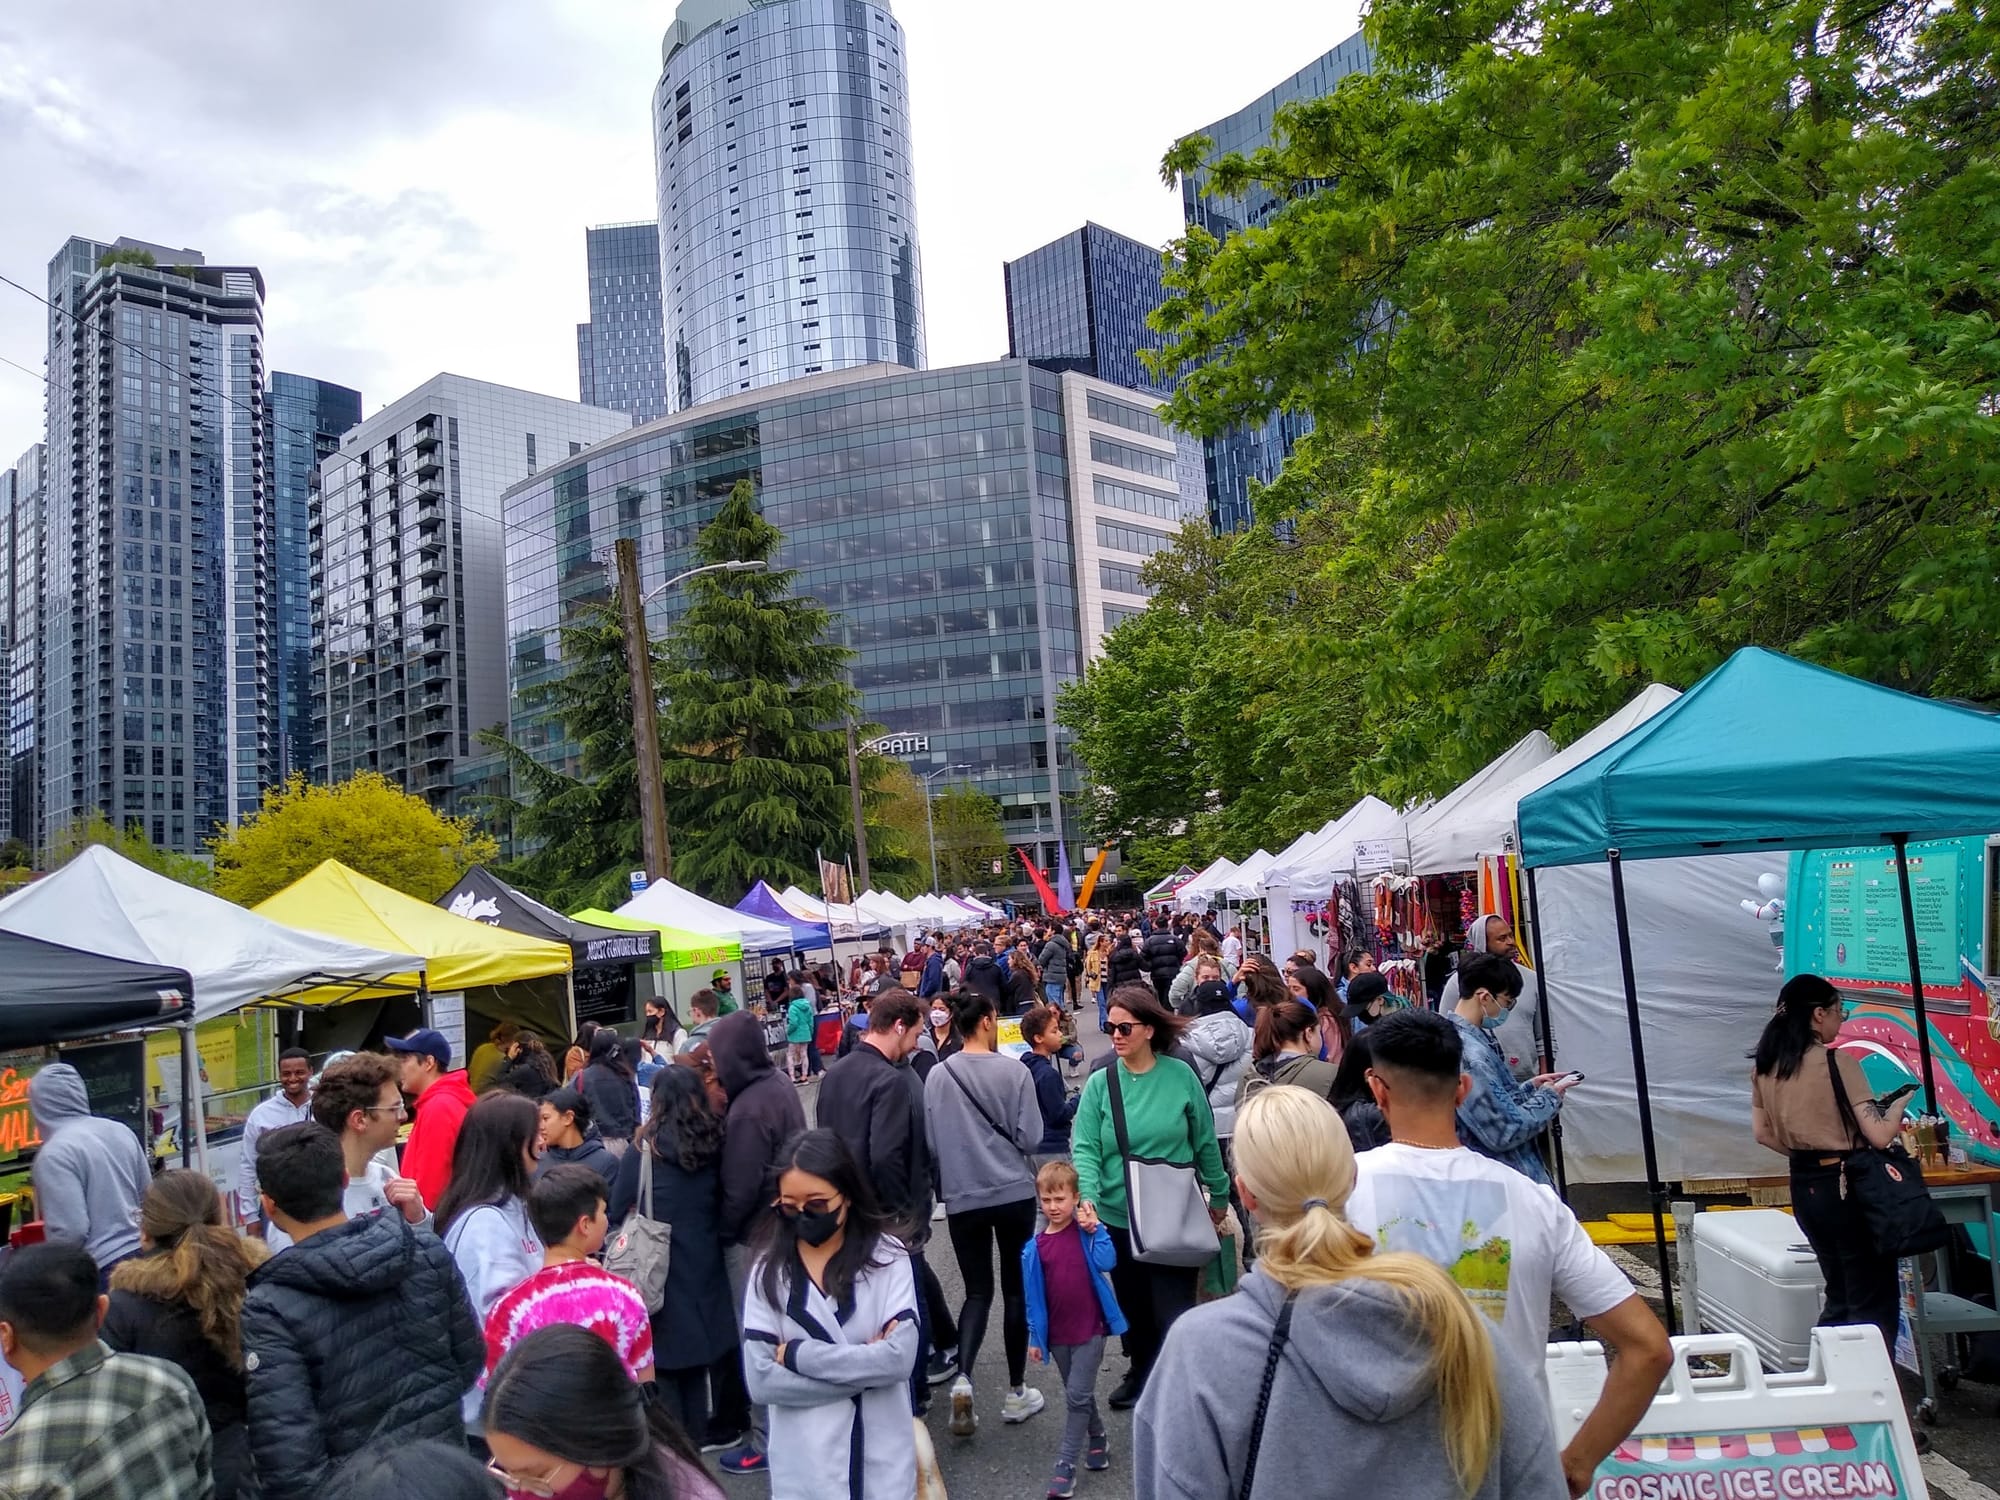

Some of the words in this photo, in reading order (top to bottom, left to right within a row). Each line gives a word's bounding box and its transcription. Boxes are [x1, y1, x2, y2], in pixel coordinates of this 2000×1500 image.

[1100, 871, 1118, 883] elm
[1597, 1472, 1717, 1500] COSMIC
[1722, 1469, 1776, 1499] ICE
[1781, 1463, 1893, 1498] CREAM
